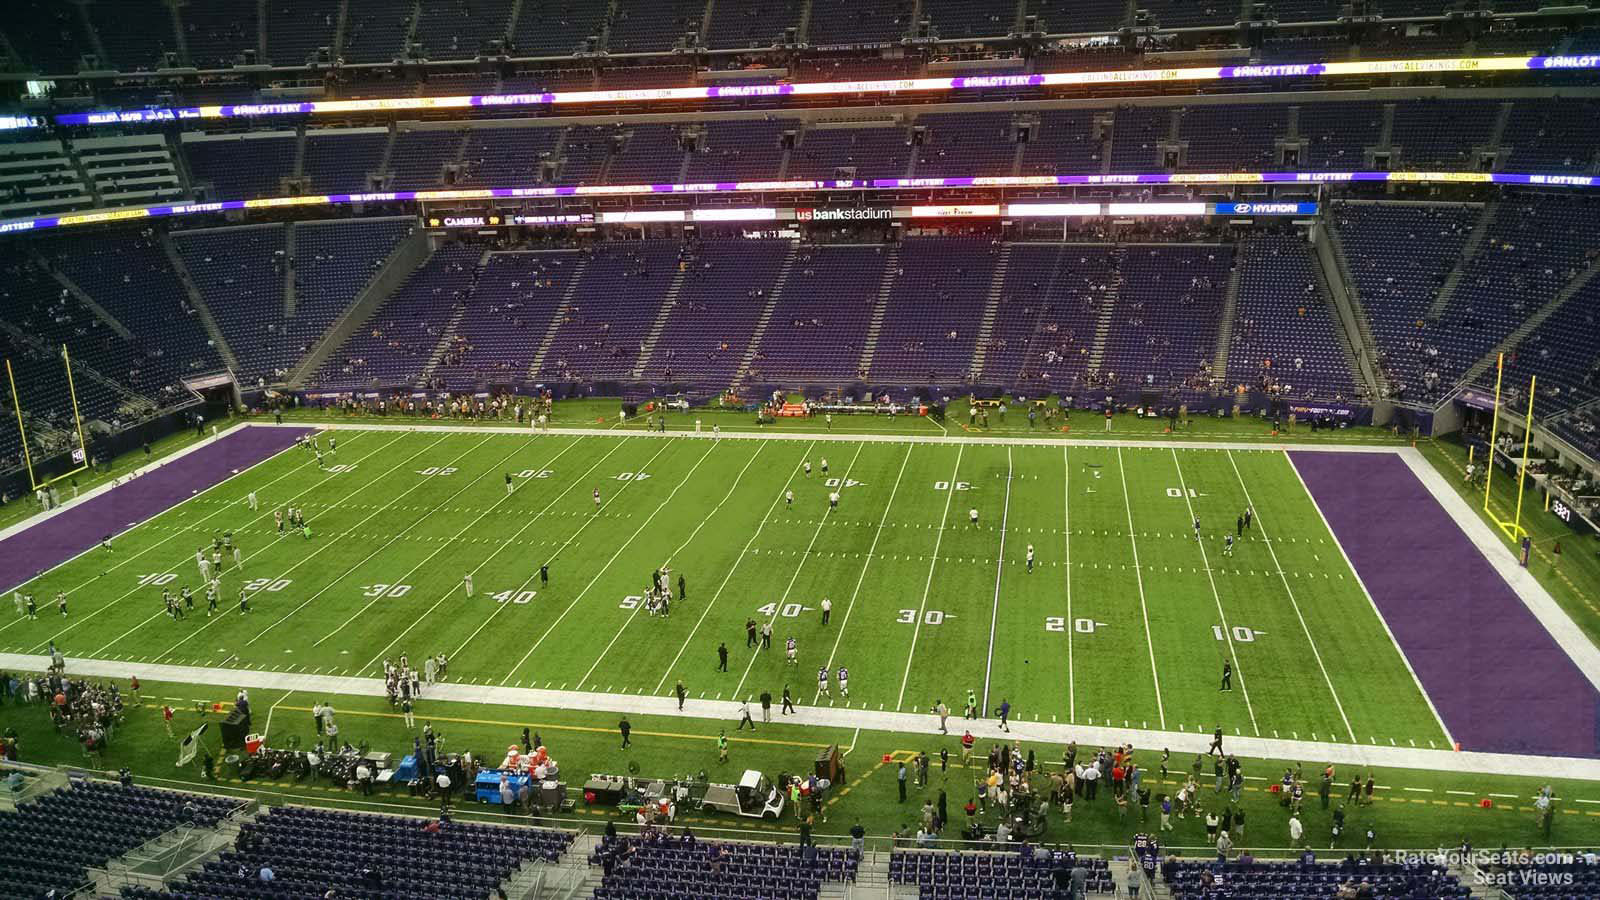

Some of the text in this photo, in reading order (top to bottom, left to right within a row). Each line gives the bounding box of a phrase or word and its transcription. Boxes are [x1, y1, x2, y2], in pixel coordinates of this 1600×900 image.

[1547, 175, 1592, 185] LOTTERY
[363, 583, 412, 598] 30
[492, 590, 536, 604] 40
[757, 602, 802, 617] 40
[896, 609, 944, 625] 30
[1045, 617, 1095, 633] 20
[1212, 625, 1255, 642] 10
